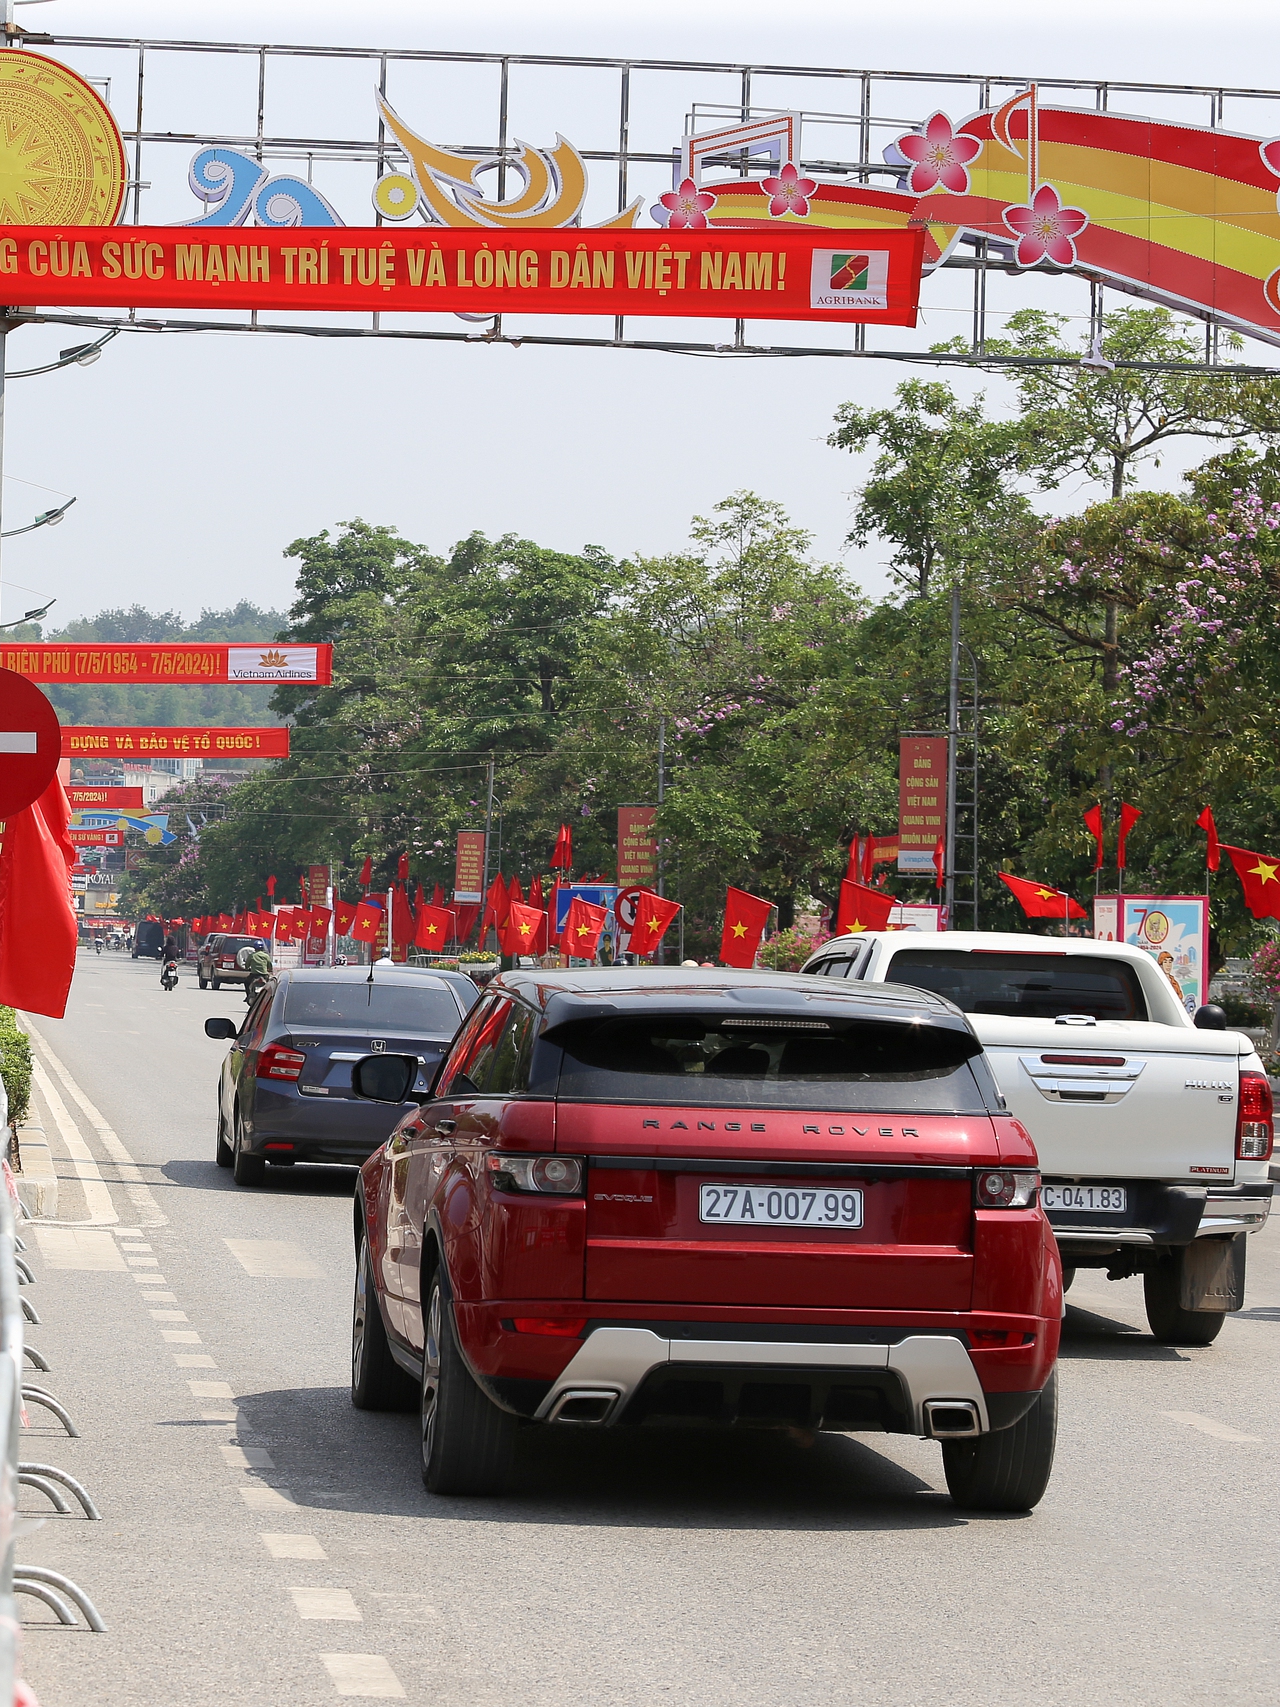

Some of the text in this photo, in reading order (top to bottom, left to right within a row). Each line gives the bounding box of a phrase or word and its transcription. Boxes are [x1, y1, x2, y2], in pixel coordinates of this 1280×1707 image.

[28, 234, 93, 278] CỦA
[102, 236, 165, 280] SỨC
[175, 243, 270, 287] MẠNH
[280, 240, 329, 285] TRÍ
[339, 241, 396, 292] TUỆ
[406, 241, 447, 288] VÀ
[457, 242, 538, 288] LÒNG
[550, 243, 614, 288] DÂN
[624, 243, 691, 296] VIỆT
[700, 252, 787, 291] NAM!
[816, 295, 881, 306] AGRIBANK
[7, 649, 40, 674] BIÊN
[42, 647, 70, 674] PHỦ
[74, 652, 137, 676] (7/5/1954
[70, 735, 109, 752] DỰNG
[115, 734, 134, 749] VÀ
[139, 732, 168, 749] BẢO
[173, 734, 191, 752] VỆ
[192, 731, 211, 749] TỔ
[913, 756, 931, 769] ĐẢNG
[906, 775, 939, 790] CỘNG SẢN
[906, 796, 937, 808] VIỆT NAM
[903, 816, 941, 826] QUANG VINH
[623, 836, 638, 848] CỘNG
[901, 833, 937, 844] MUÔN NĂM
[624, 850, 636, 861] VIỆT
[642, 1118, 920, 1138] RANGE ROVER
[593, 1193, 653, 1203] EVOQUE
[1041, 1186, 1122, 1209] C-041.83
[705, 1188, 856, 1222] 27A-007.99
